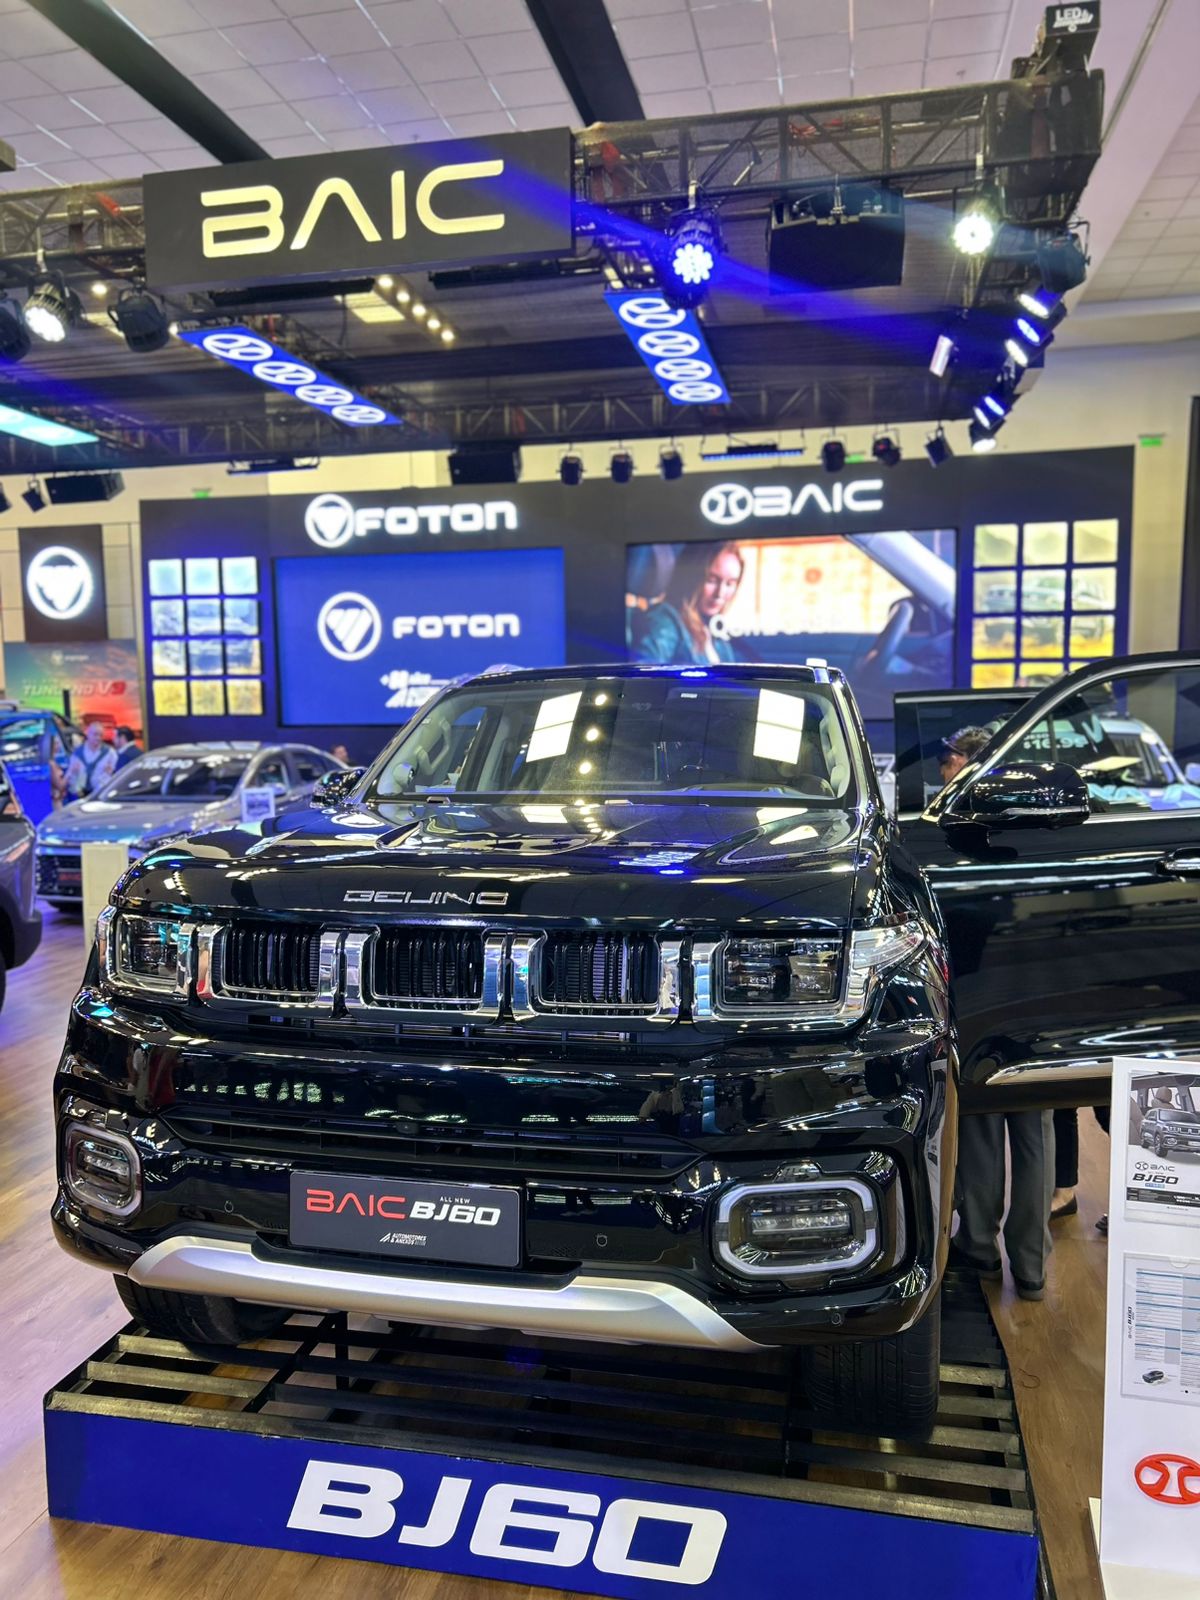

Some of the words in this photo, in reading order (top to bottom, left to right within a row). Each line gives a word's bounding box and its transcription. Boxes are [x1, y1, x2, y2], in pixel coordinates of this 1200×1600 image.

[200, 159, 505, 258] BAIC
[752, 479, 884, 517] BAIC
[354, 501, 518, 537] FOTON
[393, 613, 520, 639] FOTON
[1132, 1173, 1179, 1185] BJ60
[1150, 1163, 1175, 1172] BAIC
[306, 1188, 406, 1220] BAIC
[409, 1200, 501, 1226] BJ60
[286, 1459, 728, 1586] BJ60
